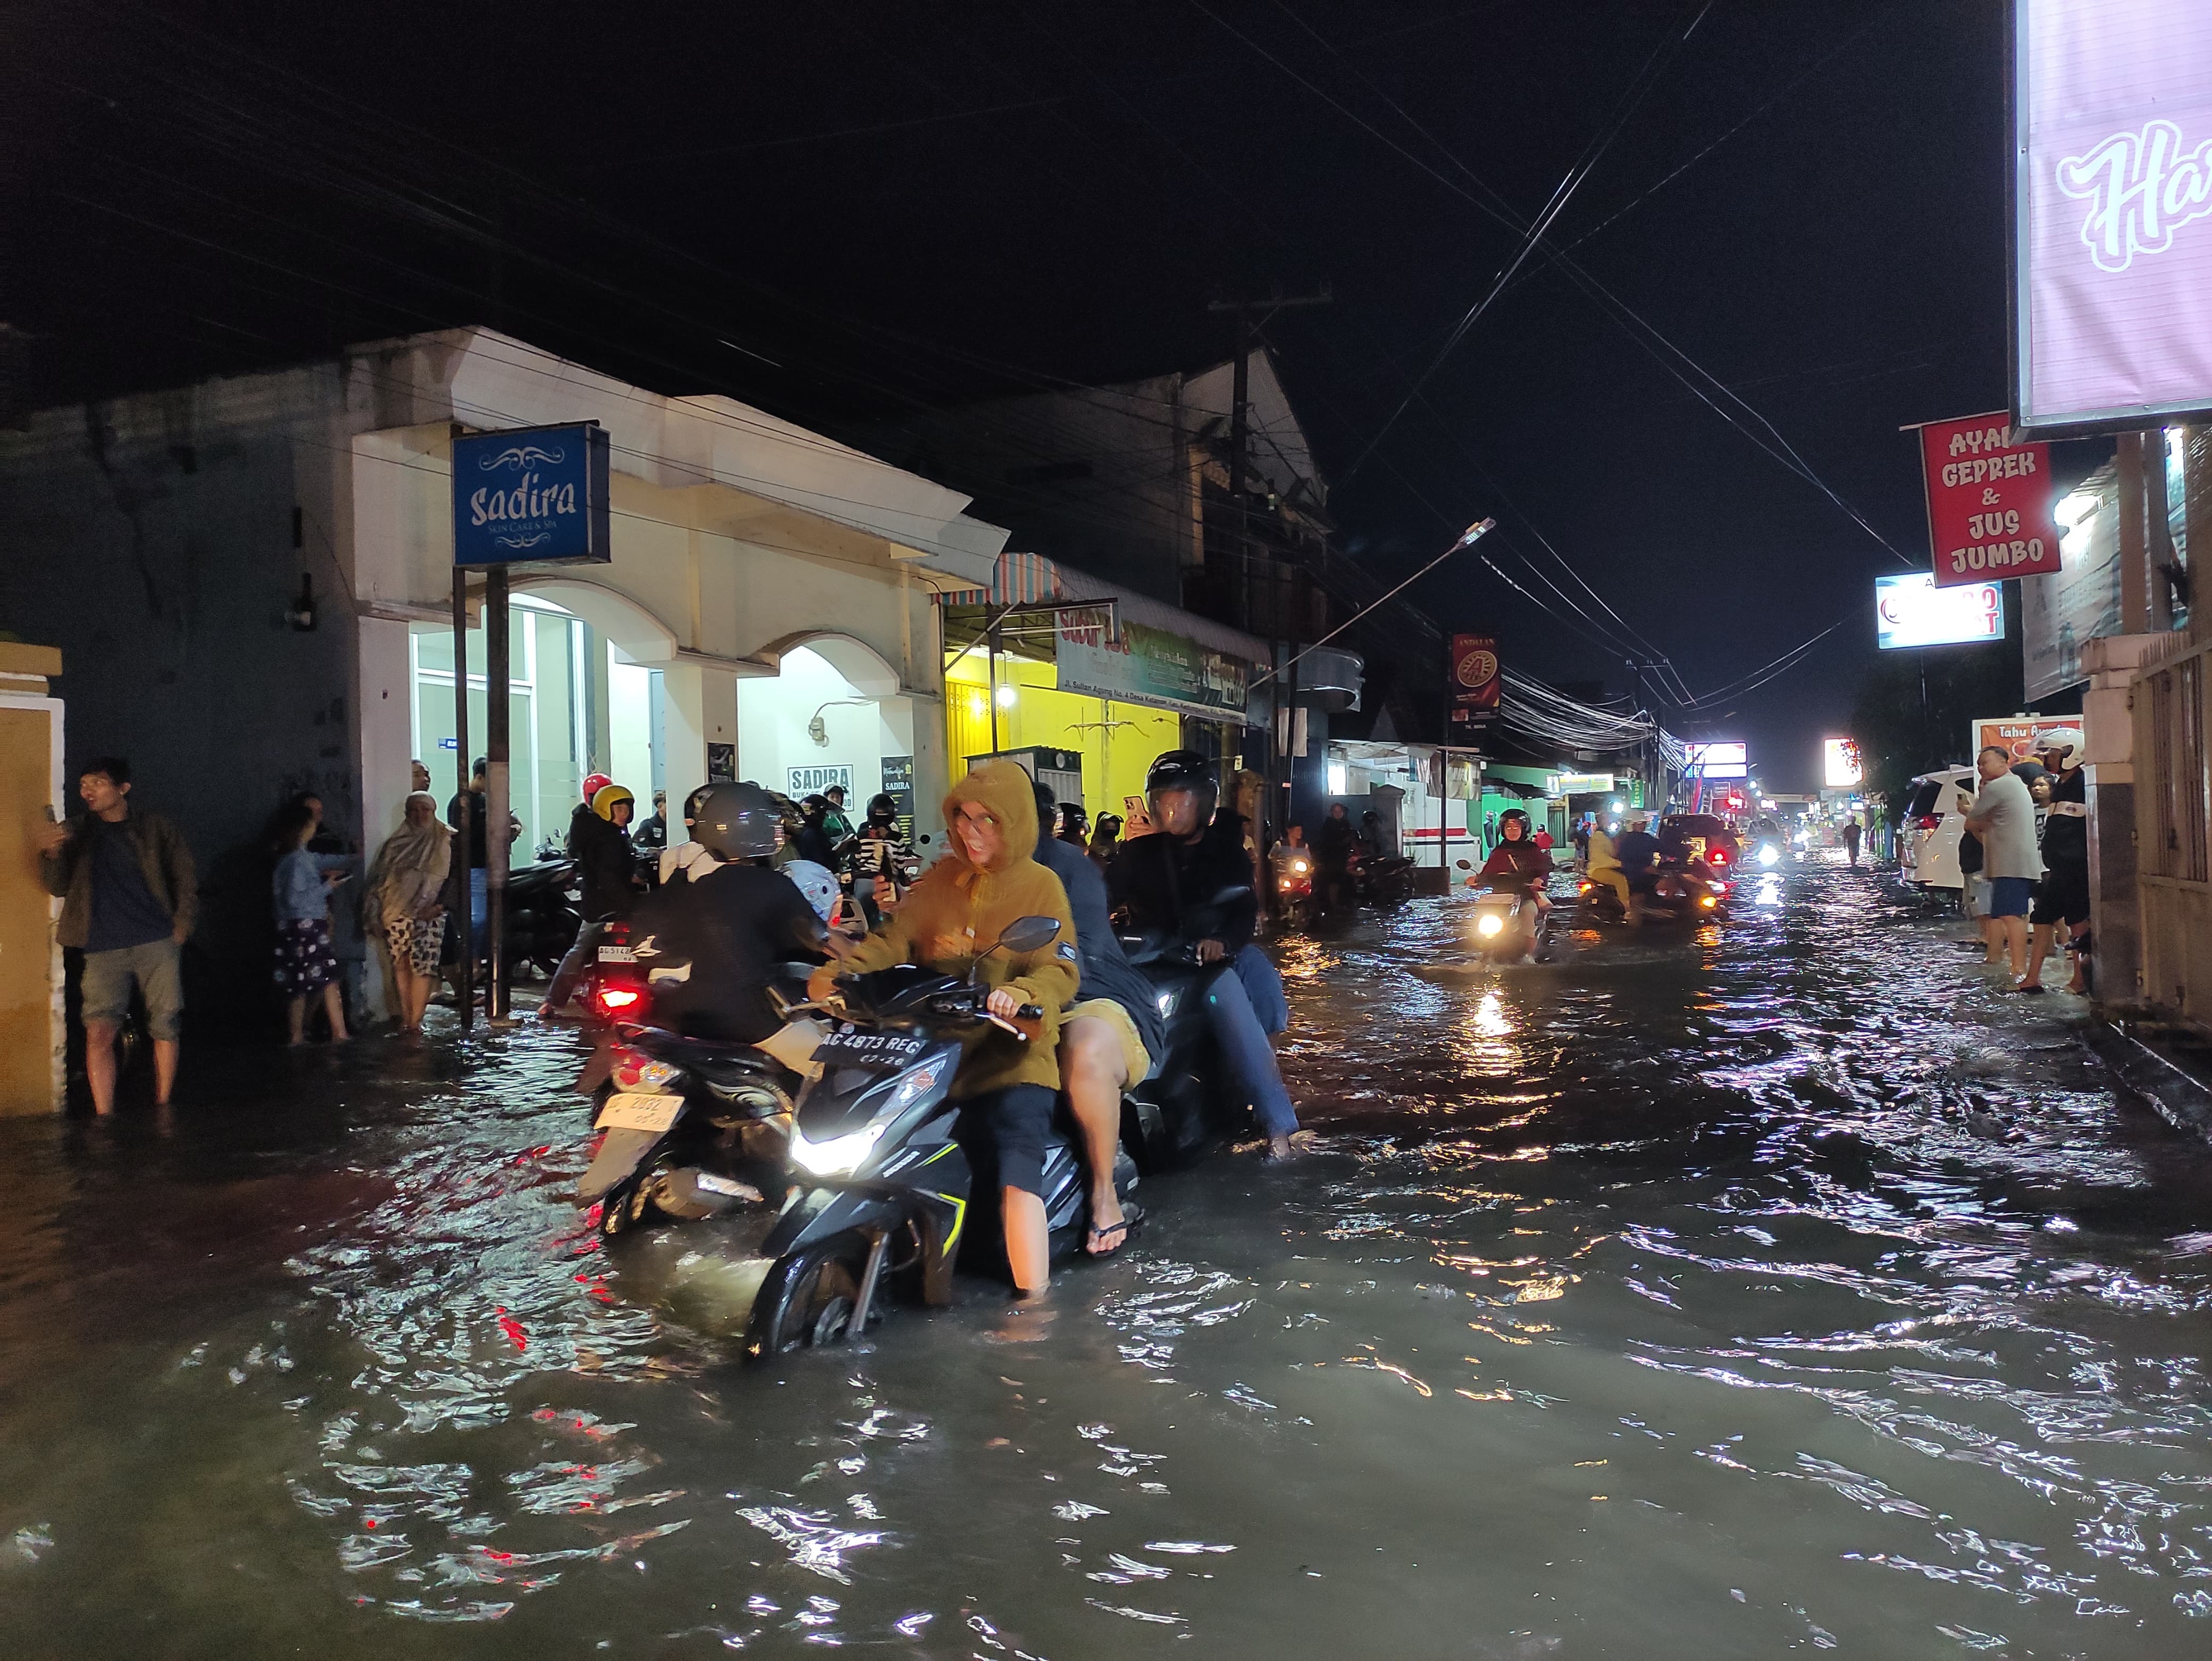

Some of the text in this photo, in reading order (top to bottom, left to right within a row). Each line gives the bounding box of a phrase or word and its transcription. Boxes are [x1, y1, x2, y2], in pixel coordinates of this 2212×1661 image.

[1942, 452, 2036, 488] GEPREK
[471, 472, 576, 526] sadira
[1982, 487, 2001, 505] &
[1968, 509, 2020, 539] JUS
[1951, 538, 2044, 573] JUMBO
[1093, 685, 1112, 697] Agung
[1999, 725, 2027, 738] Tahu
[792, 769, 849, 789] SADIRA
[885, 782, 910, 790] SADIRA
[843, 1035, 885, 1049] 4873
